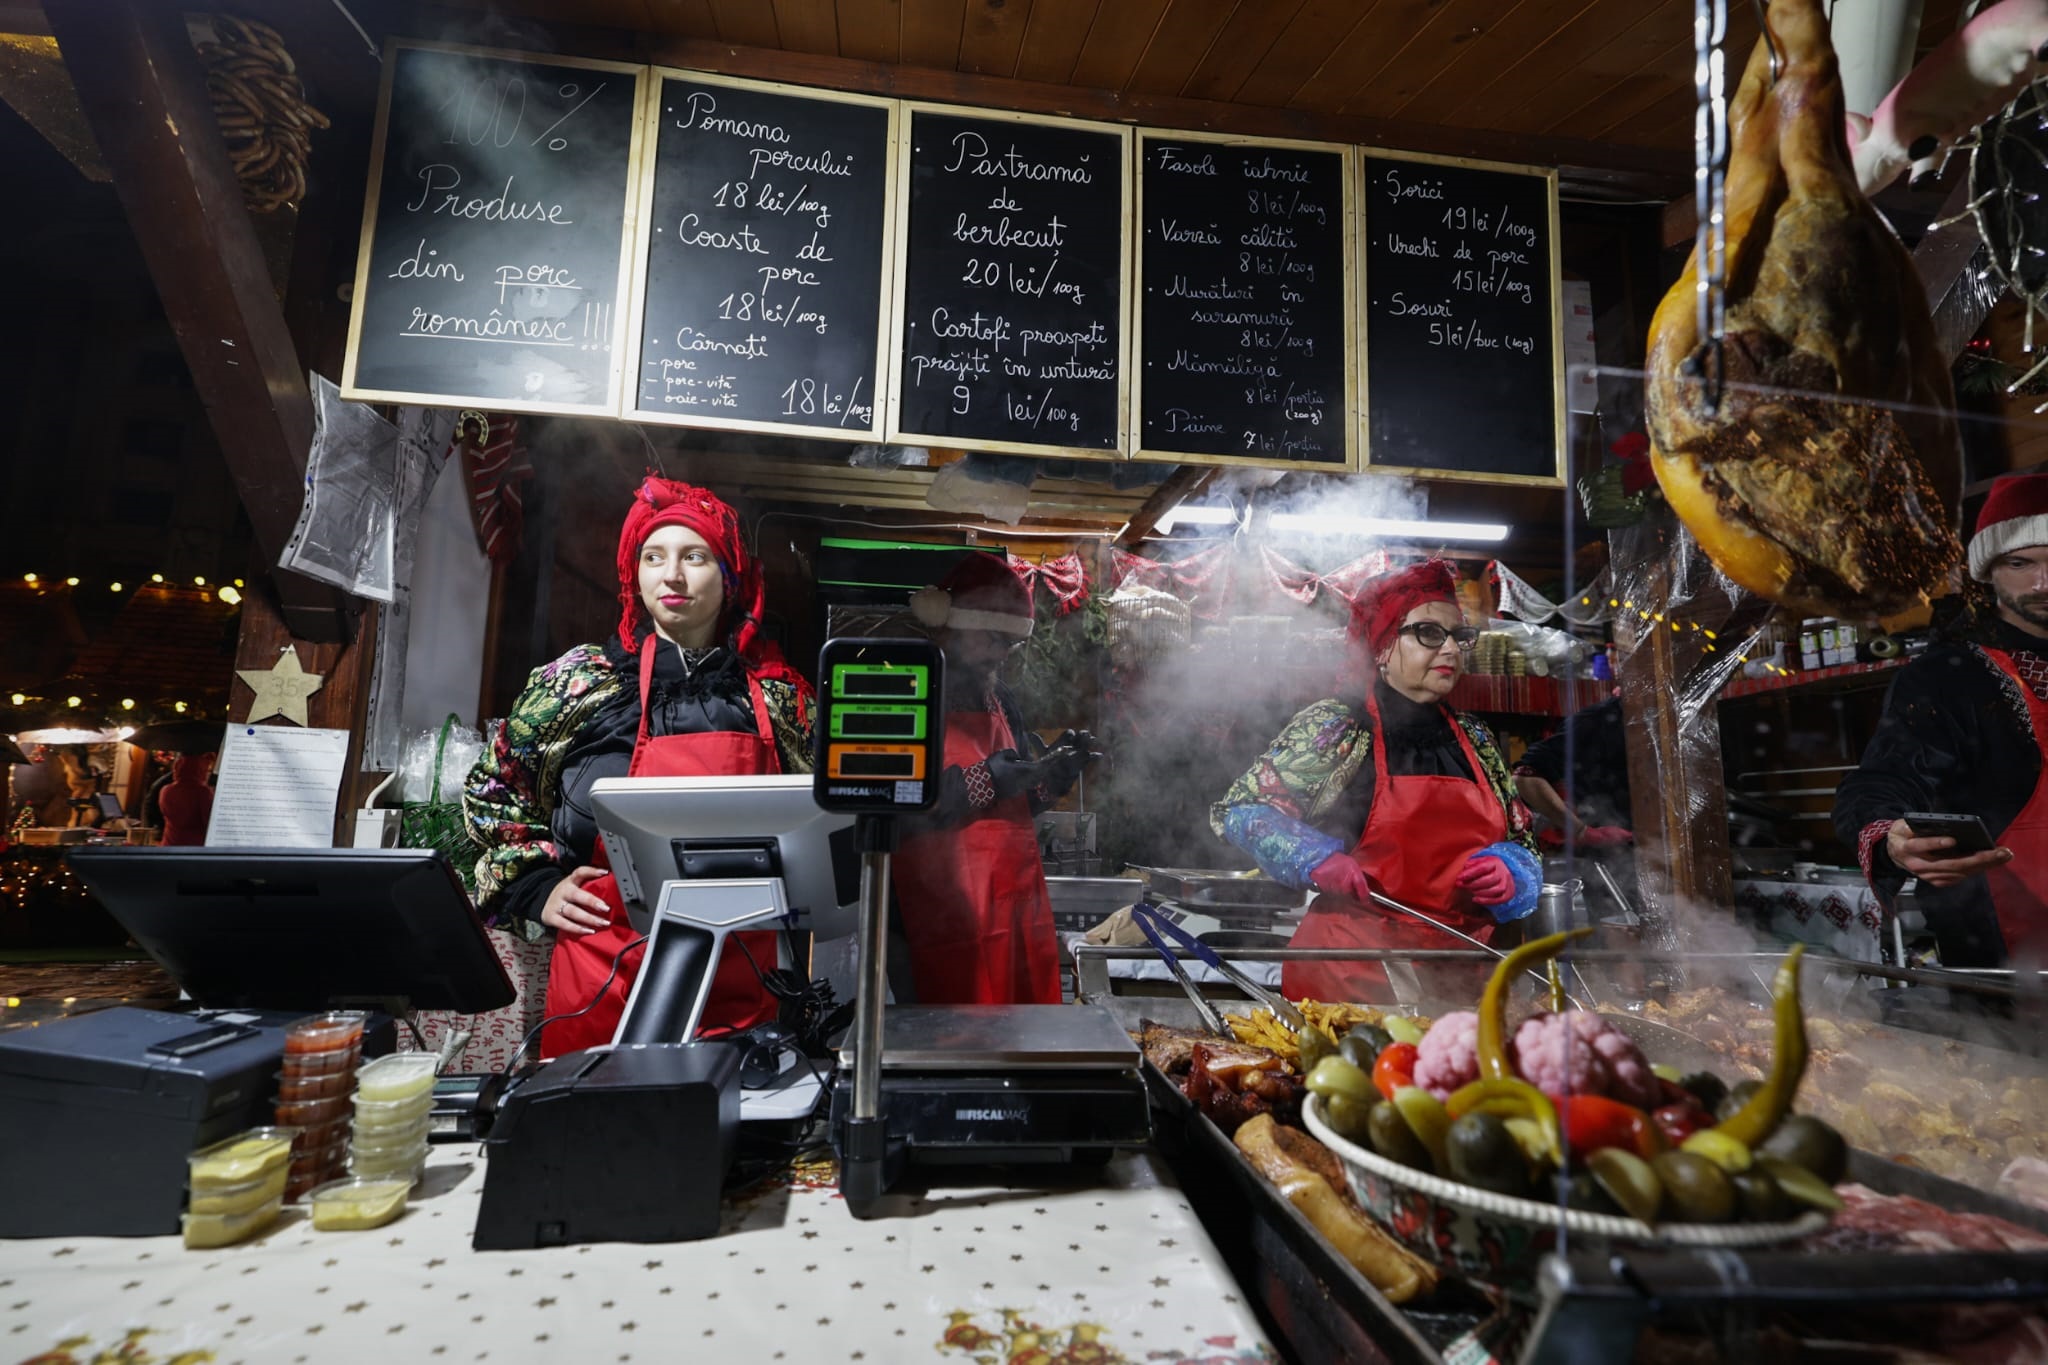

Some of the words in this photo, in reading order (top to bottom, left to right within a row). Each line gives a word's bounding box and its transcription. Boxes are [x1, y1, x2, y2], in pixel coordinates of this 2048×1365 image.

[677, 92, 790, 144] Pomana
[750, 148, 852, 180] porcului
[944, 131, 1092, 184] Pastramă
[1157, 147, 1218, 176] Fasole
[1243, 157, 1312, 183] iahnie
[407, 164, 573, 224] Produse
[713, 182, 749, 208] 18
[988, 186, 1023, 211] de
[1386, 169, 1444, 204] Șorici
[1248, 190, 1259, 214] 8
[1161, 218, 1222, 245] Varză
[1240, 223, 1297, 248] călită
[1441, 207, 1466, 231] 19
[679, 213, 769, 254] Coaste
[796, 231, 834, 262] de
[953, 213, 1067, 257] berbecuț
[1239, 252, 1251, 273] 8
[1388, 233, 1440, 258] Urechi
[1453, 240, 1473, 261] de
[1487, 251, 1529, 275] porc
[389, 239, 464, 282] din
[495, 265, 576, 304] porc
[758, 267, 821, 296] porc
[962, 259, 1000, 286] 20
[1451, 270, 1473, 292] 15
[1164, 274, 1254, 300] Murături
[1280, 284, 1304, 303] în
[718, 293, 755, 320] 18
[1191, 308, 1294, 326] saramură
[1388, 292, 1453, 317] Sosuri
[677, 327, 768, 360] Cârnați
[932, 307, 1011, 352] Cartofi
[1020, 320, 1108, 357] proaspeți
[1240, 329, 1251, 347] 8
[1428, 322, 1443, 345] 5
[660, 359, 697, 379] porc
[911, 348, 991, 387] prăjiți
[1003, 358, 1031, 377] în
[1040, 356, 1115, 380] untură
[781, 378, 815, 416] 18
[953, 385, 970, 415] 9
[1245, 388, 1255, 404] 8
[1243, 430, 1257, 449] 7
[271, 677, 299, 697] 35
